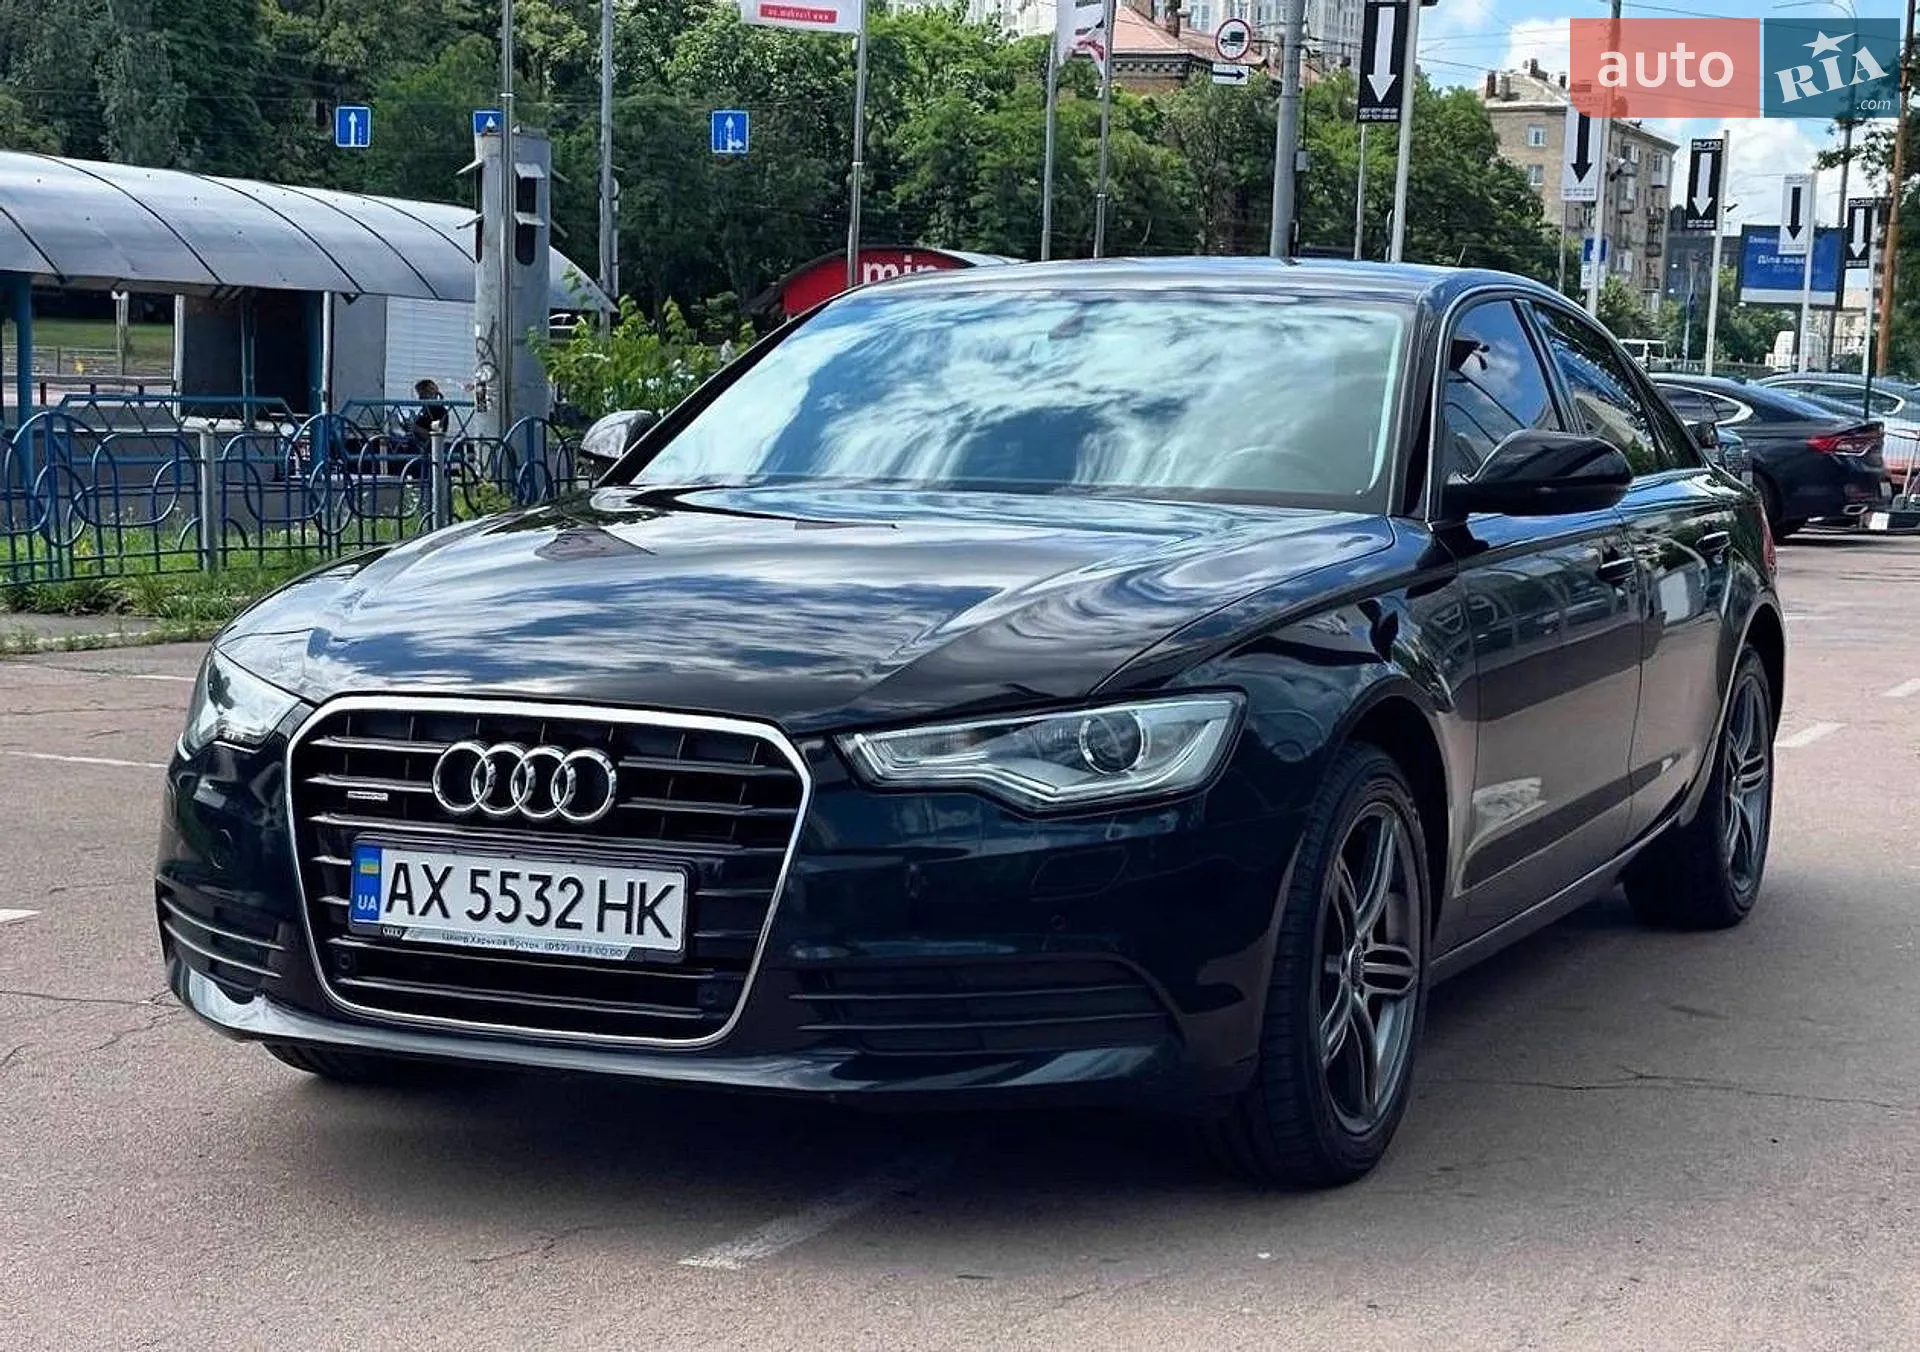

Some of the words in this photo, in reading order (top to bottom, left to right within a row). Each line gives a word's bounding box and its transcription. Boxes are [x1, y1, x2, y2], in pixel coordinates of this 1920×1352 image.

[863, 254, 937, 285] mi
[357, 894, 378, 911] UA
[385, 862, 454, 919] AX
[465, 868, 584, 930] 5532
[596, 878, 678, 939] HK
